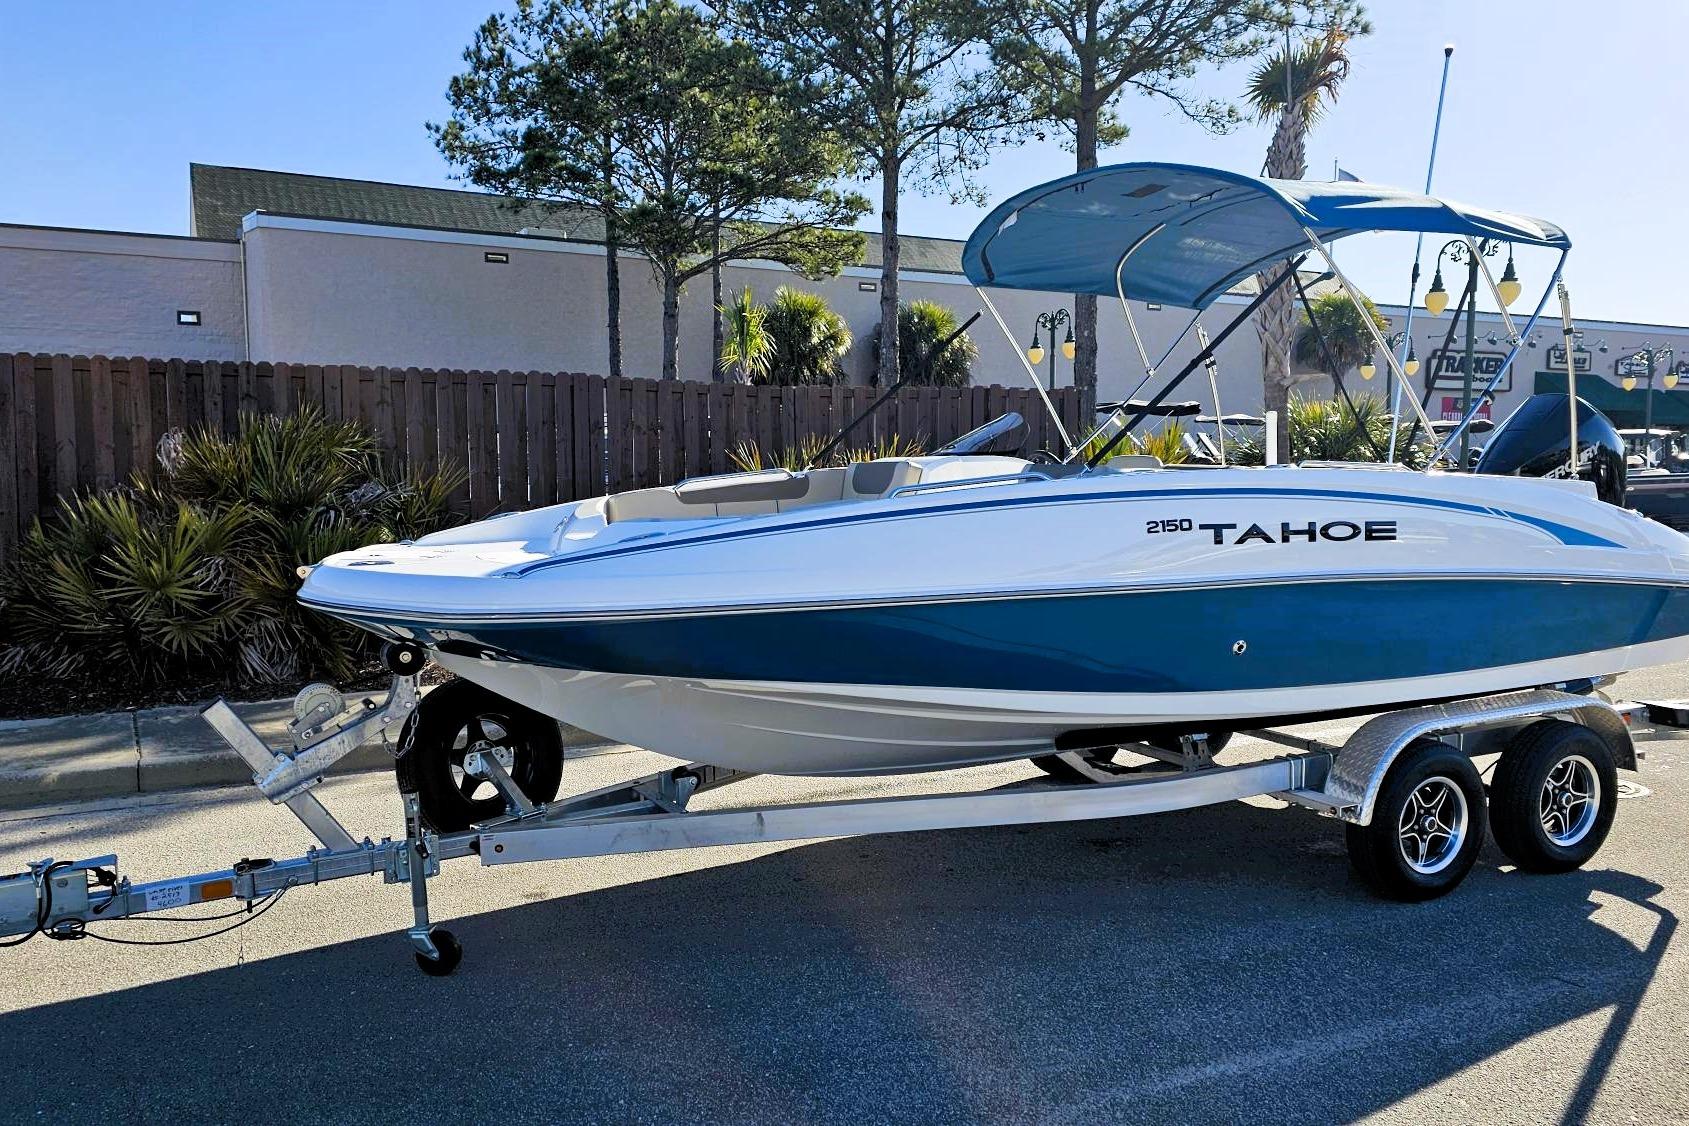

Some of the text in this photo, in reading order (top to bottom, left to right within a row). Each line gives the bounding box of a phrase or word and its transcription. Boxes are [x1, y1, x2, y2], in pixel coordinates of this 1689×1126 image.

[1437, 355, 1505, 374] TRAKER
[1541, 440, 1600, 479] ERCURY
[1146, 518, 1397, 545] 2150 TAHOE
